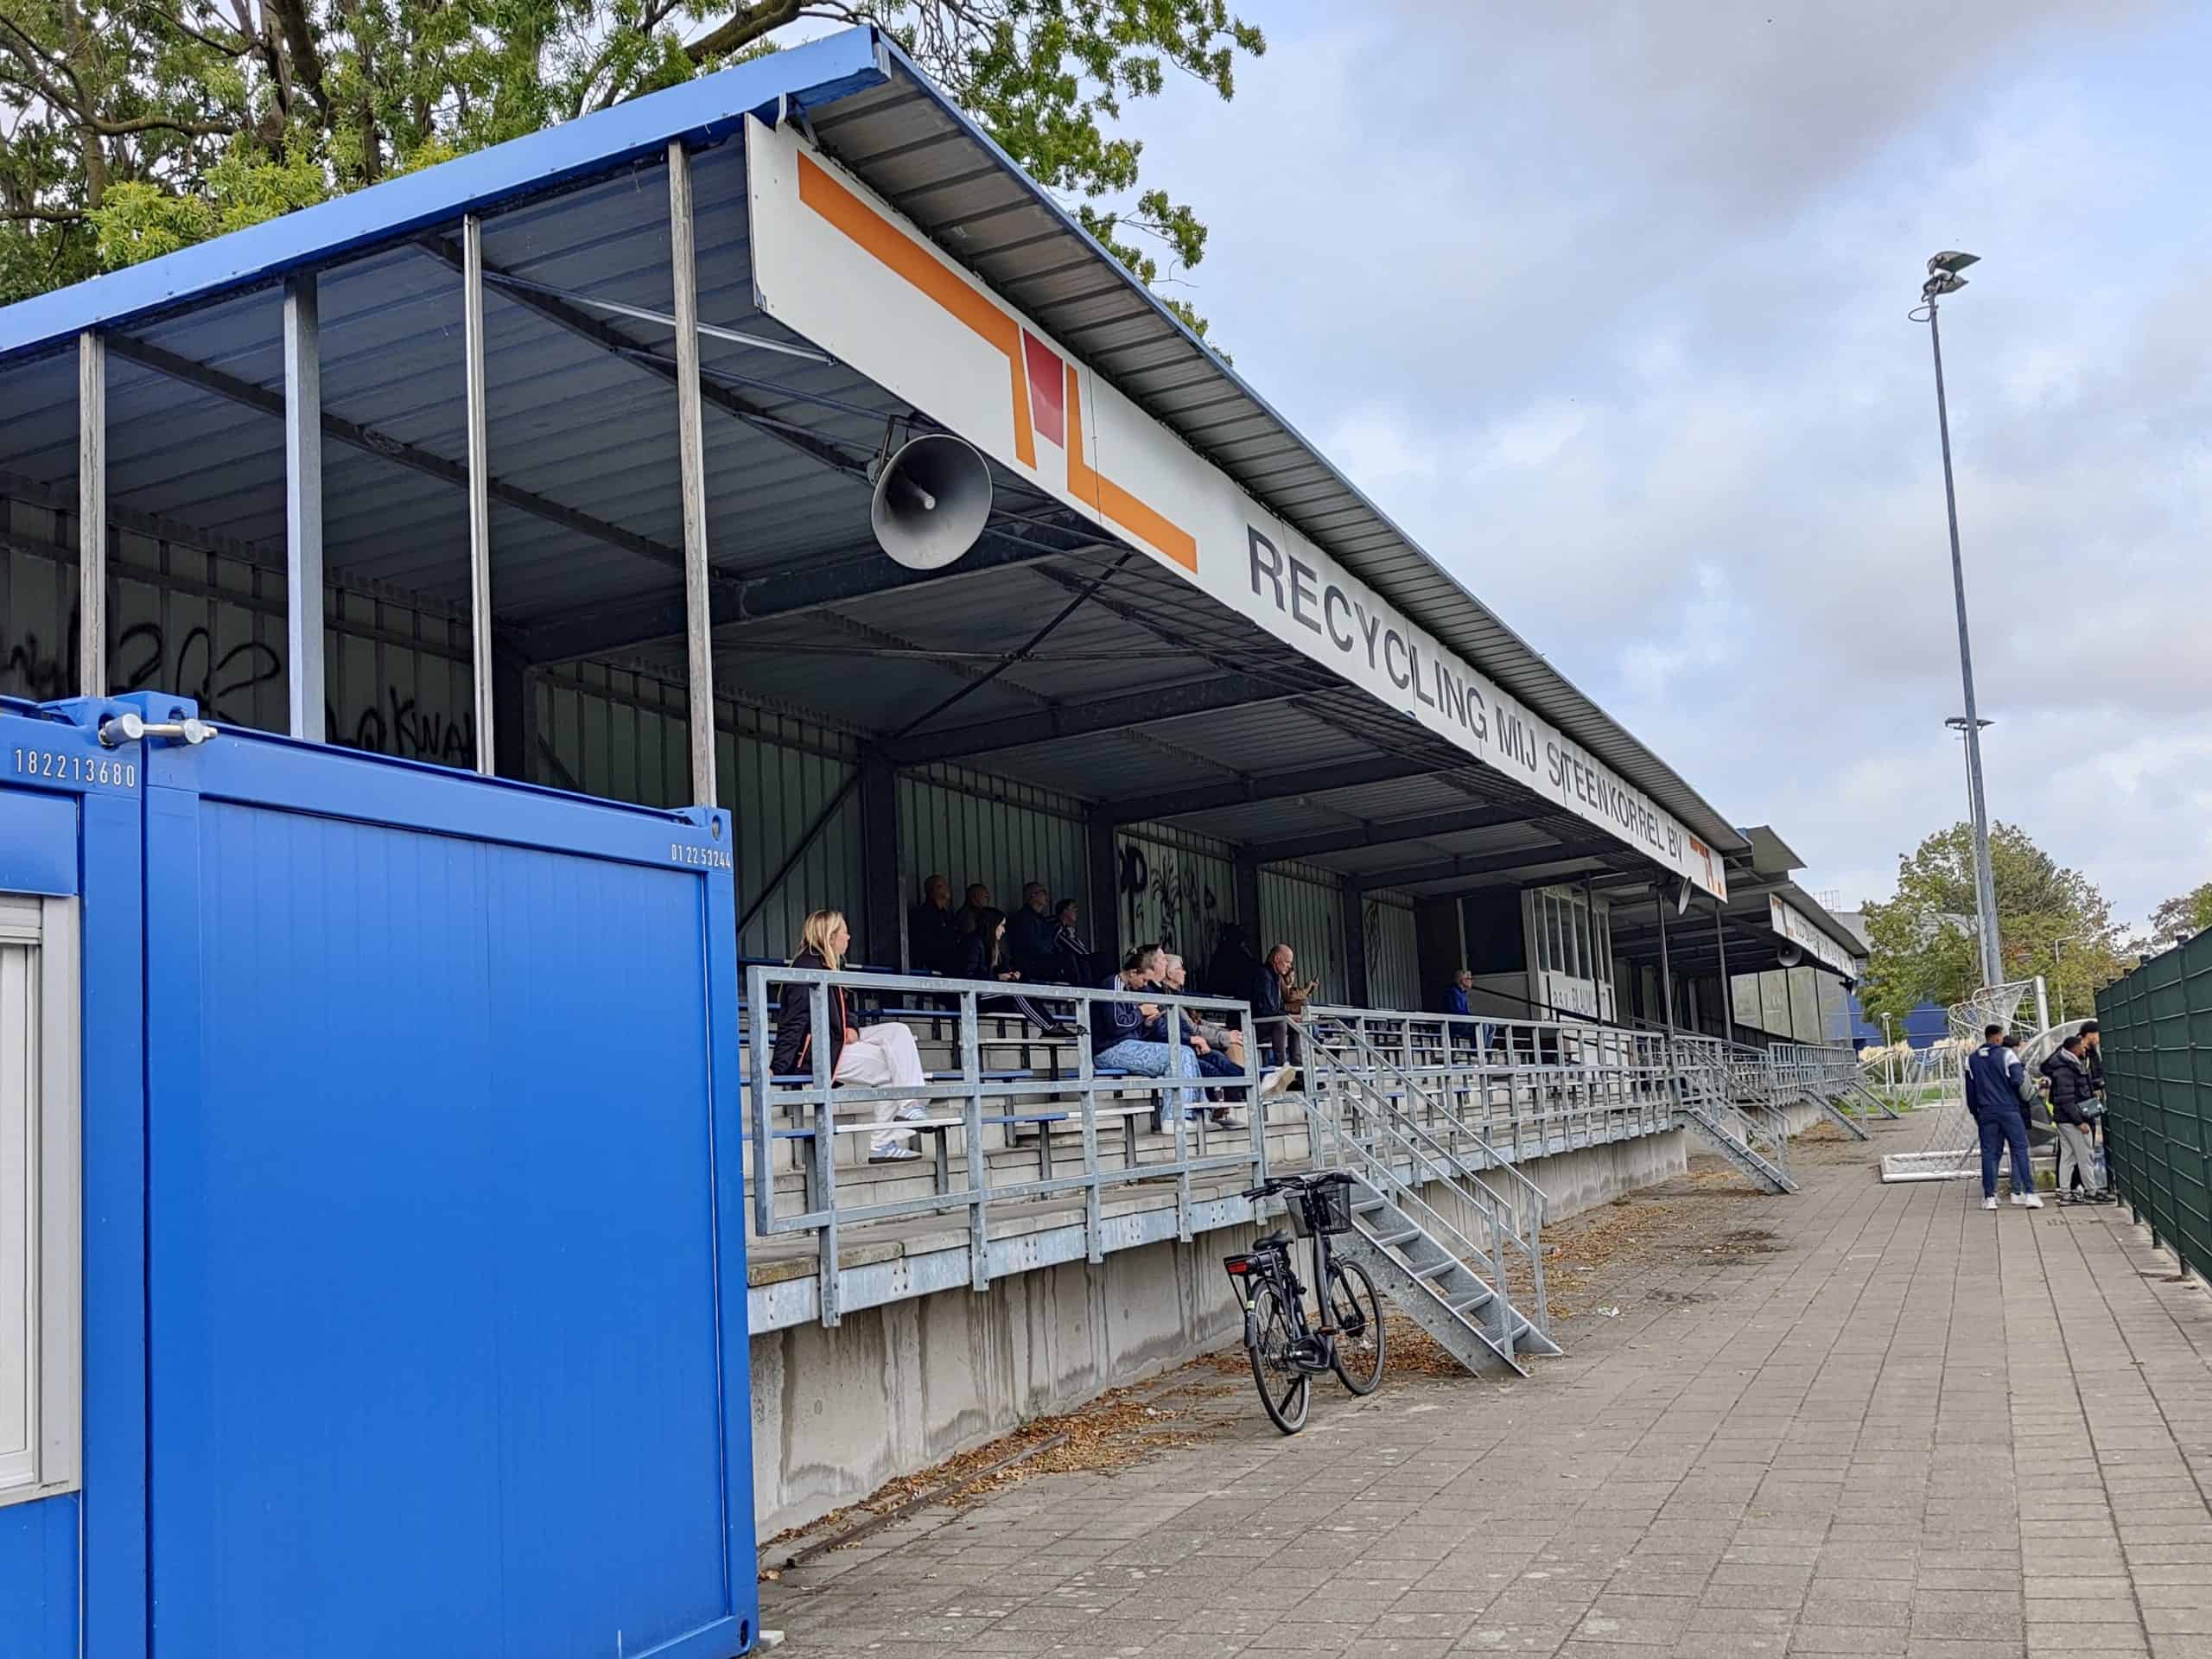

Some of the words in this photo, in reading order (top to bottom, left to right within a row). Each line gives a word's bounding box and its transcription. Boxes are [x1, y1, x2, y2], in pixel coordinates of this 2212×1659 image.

[14, 748, 135, 788] 182213680
[1246, 524, 1489, 741] RECYCLING
[1496, 706, 1537, 772] MIJ
[1547, 741, 1665, 851] STEENKORREL
[1667, 826, 1683, 864] BV
